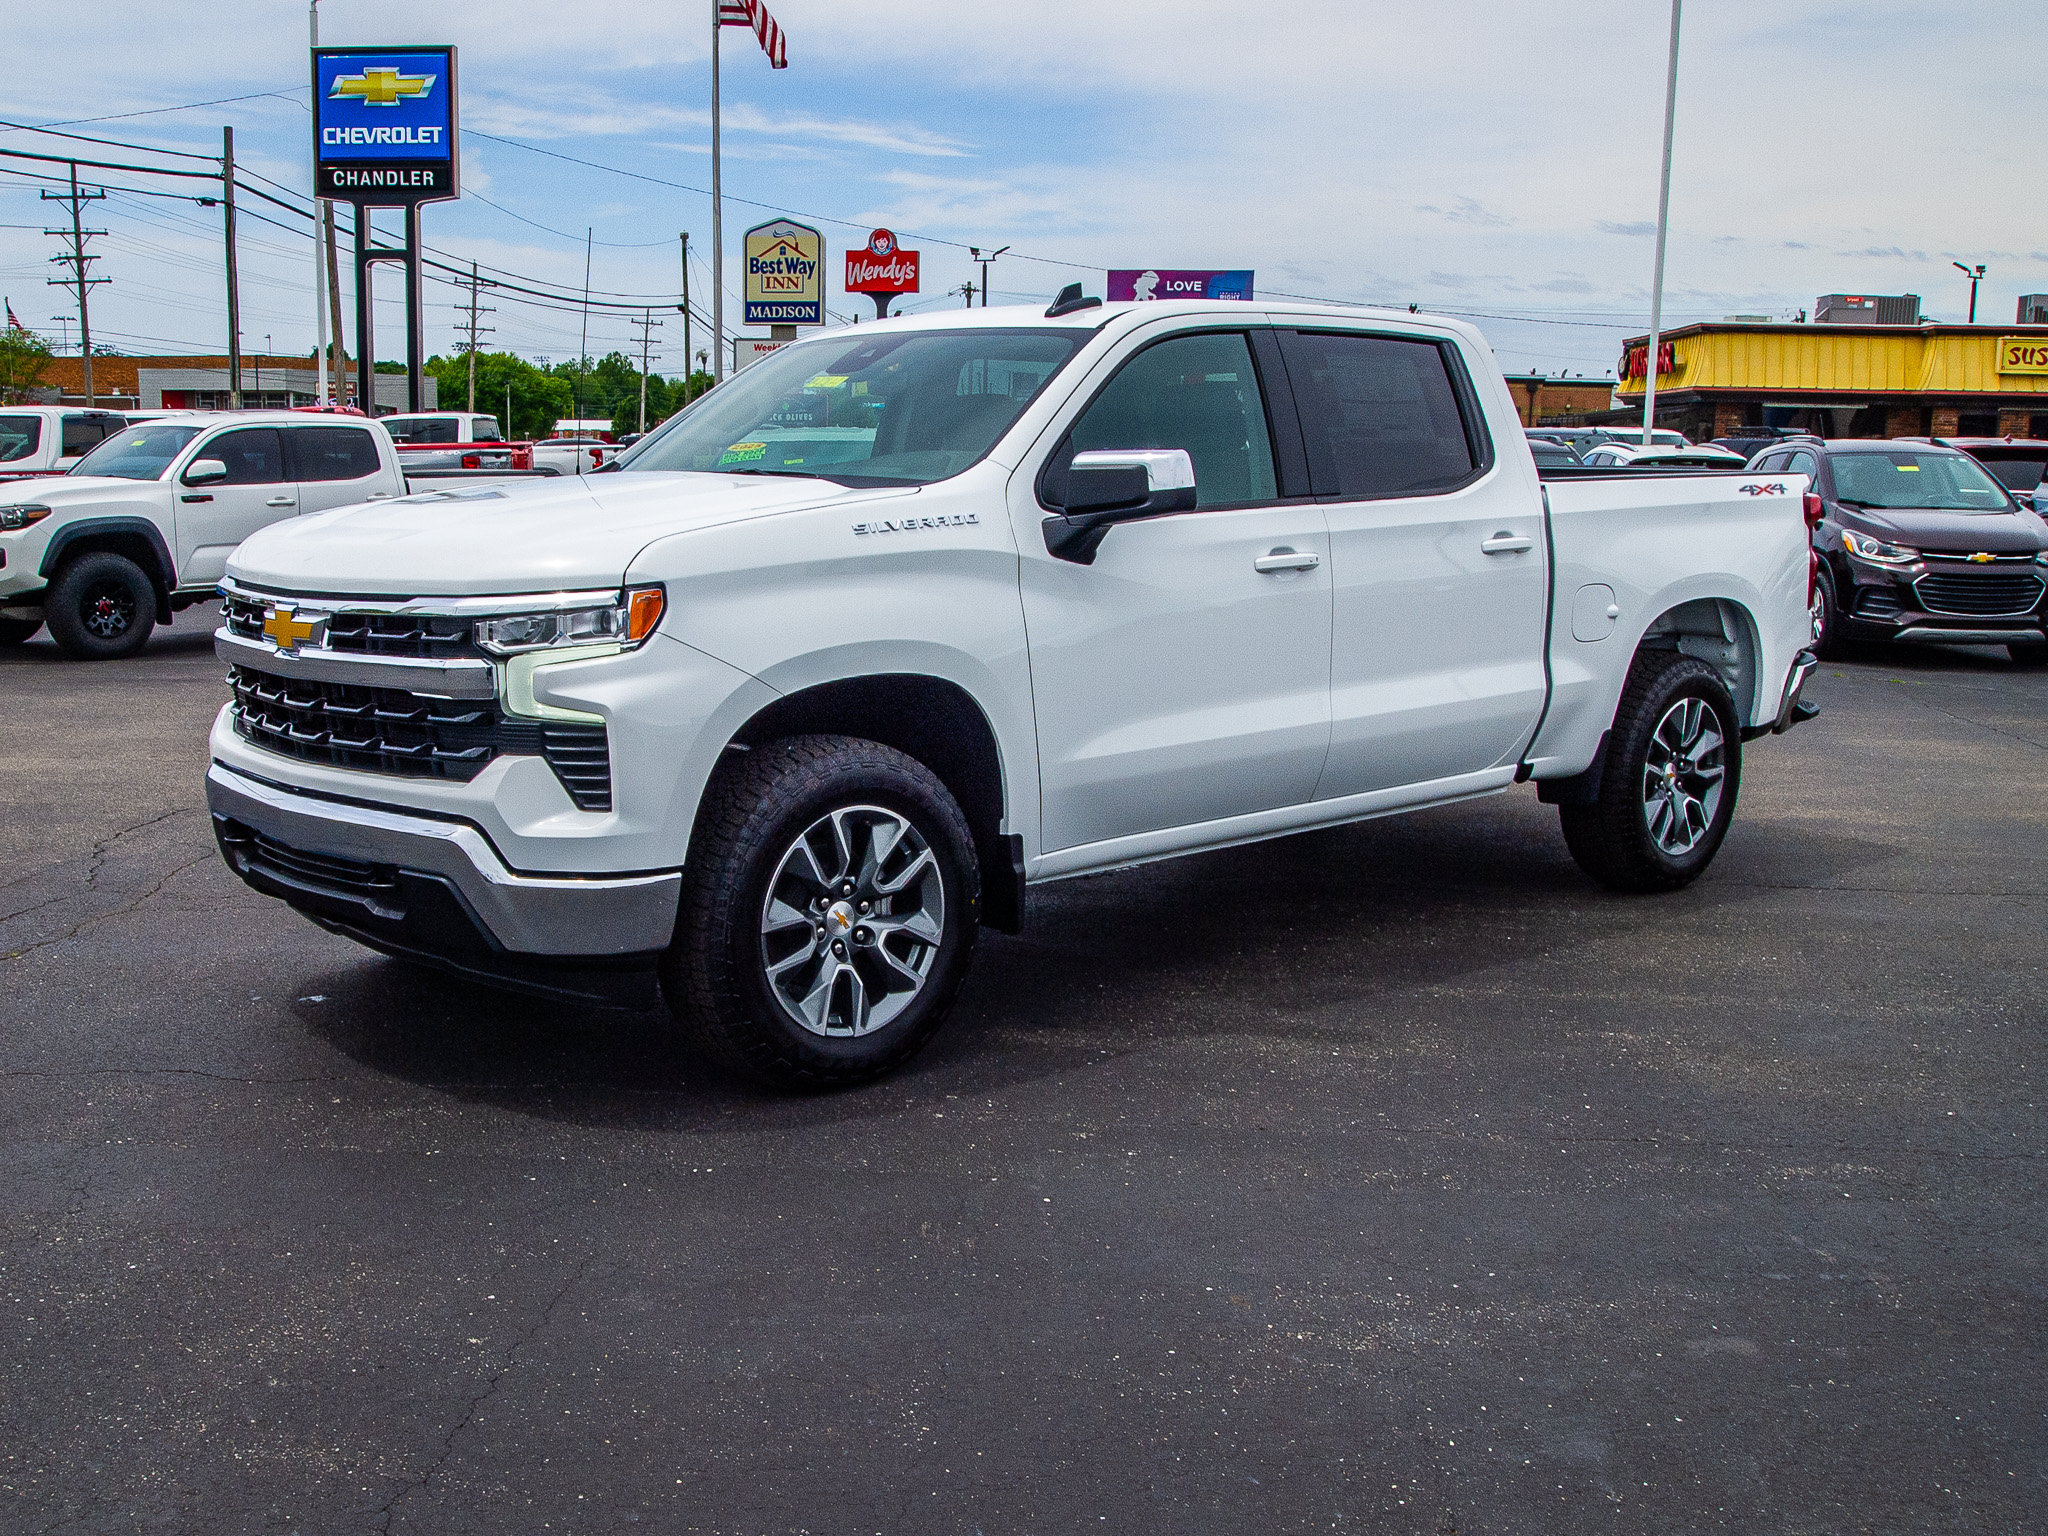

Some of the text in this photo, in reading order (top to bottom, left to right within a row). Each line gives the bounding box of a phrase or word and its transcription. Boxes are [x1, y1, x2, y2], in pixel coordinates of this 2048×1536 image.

[323, 126, 443, 144] CHEVROLET
[333, 170, 434, 186] CHANDLER
[749, 257, 817, 280] Best Way
[848, 256, 916, 286] Wendy's
[765, 276, 800, 290] INN
[1166, 280, 1202, 292] LOVE
[749, 306, 816, 318] MADISON
[852, 513, 980, 535] SILVERADO
